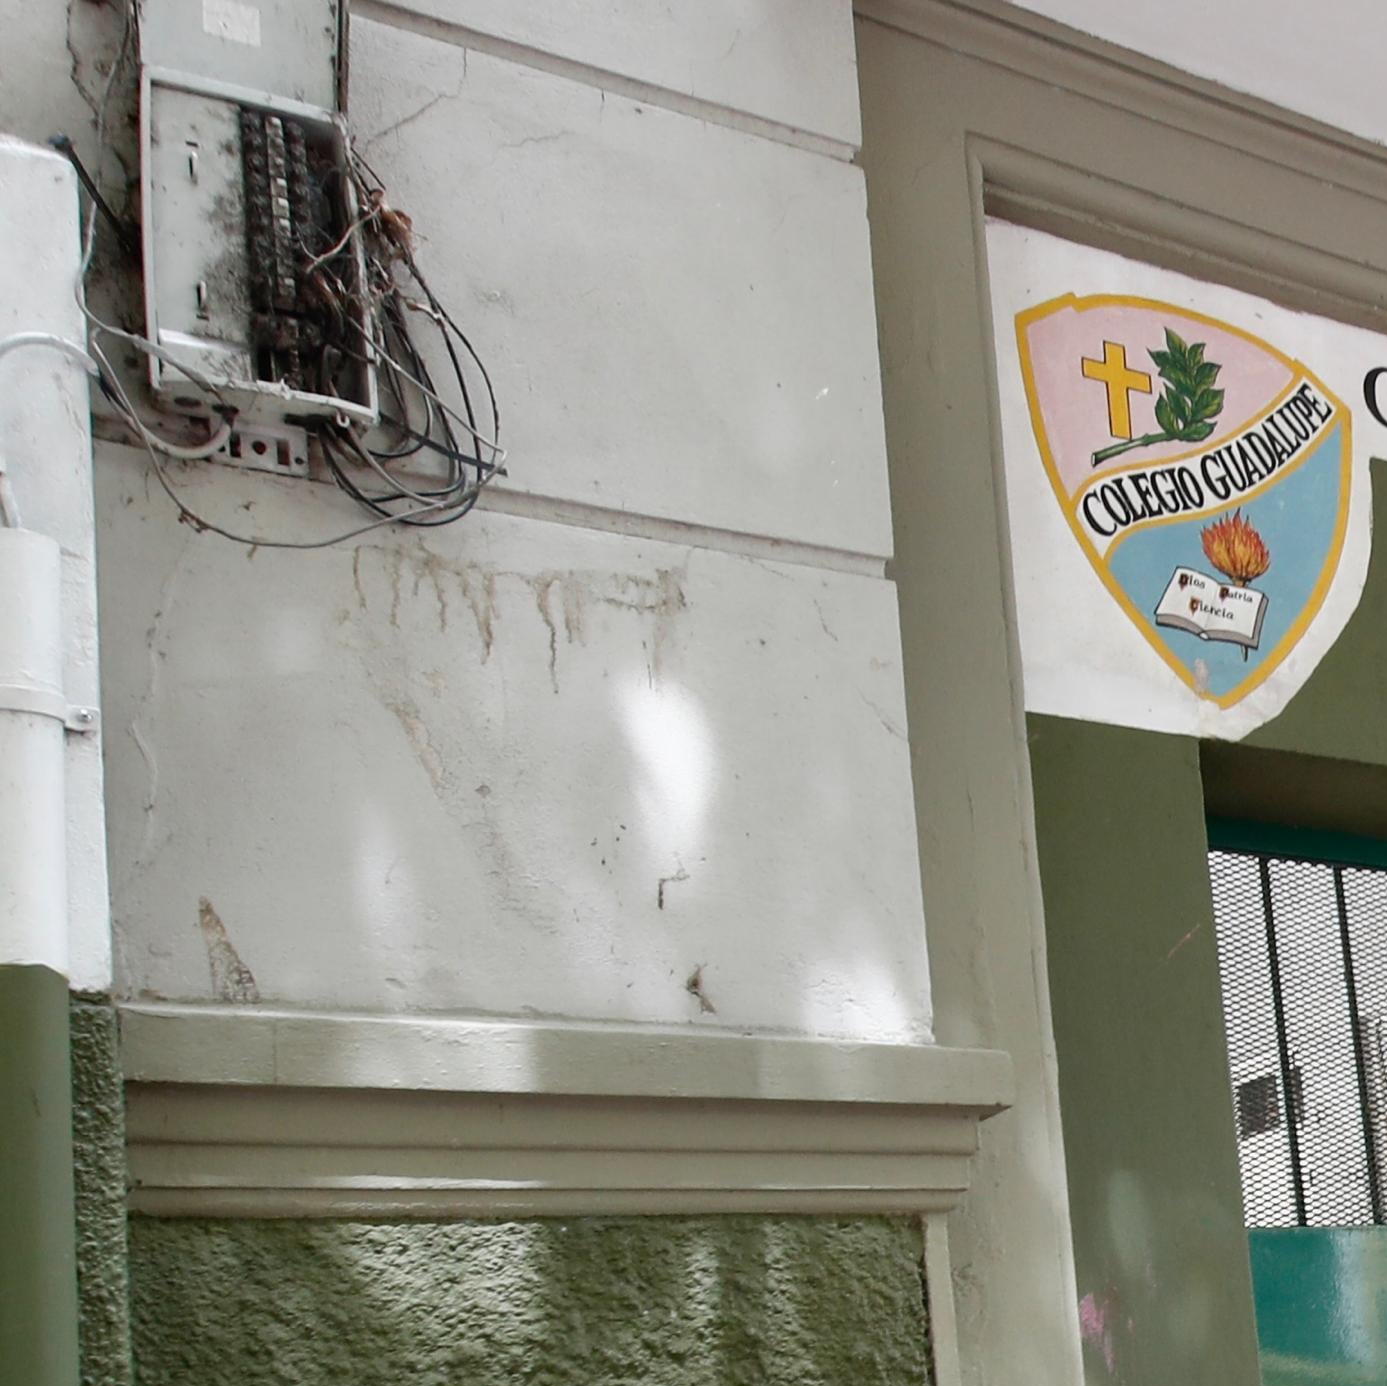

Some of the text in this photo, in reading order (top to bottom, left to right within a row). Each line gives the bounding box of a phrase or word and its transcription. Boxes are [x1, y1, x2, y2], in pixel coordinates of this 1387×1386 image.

[1083, 382, 1333, 537] COLEGIO GUADALUPE
[1178, 572, 1206, 591] Dios
[1219, 586, 1254, 603] Patria
[1189, 597, 1234, 621] Ciencia
